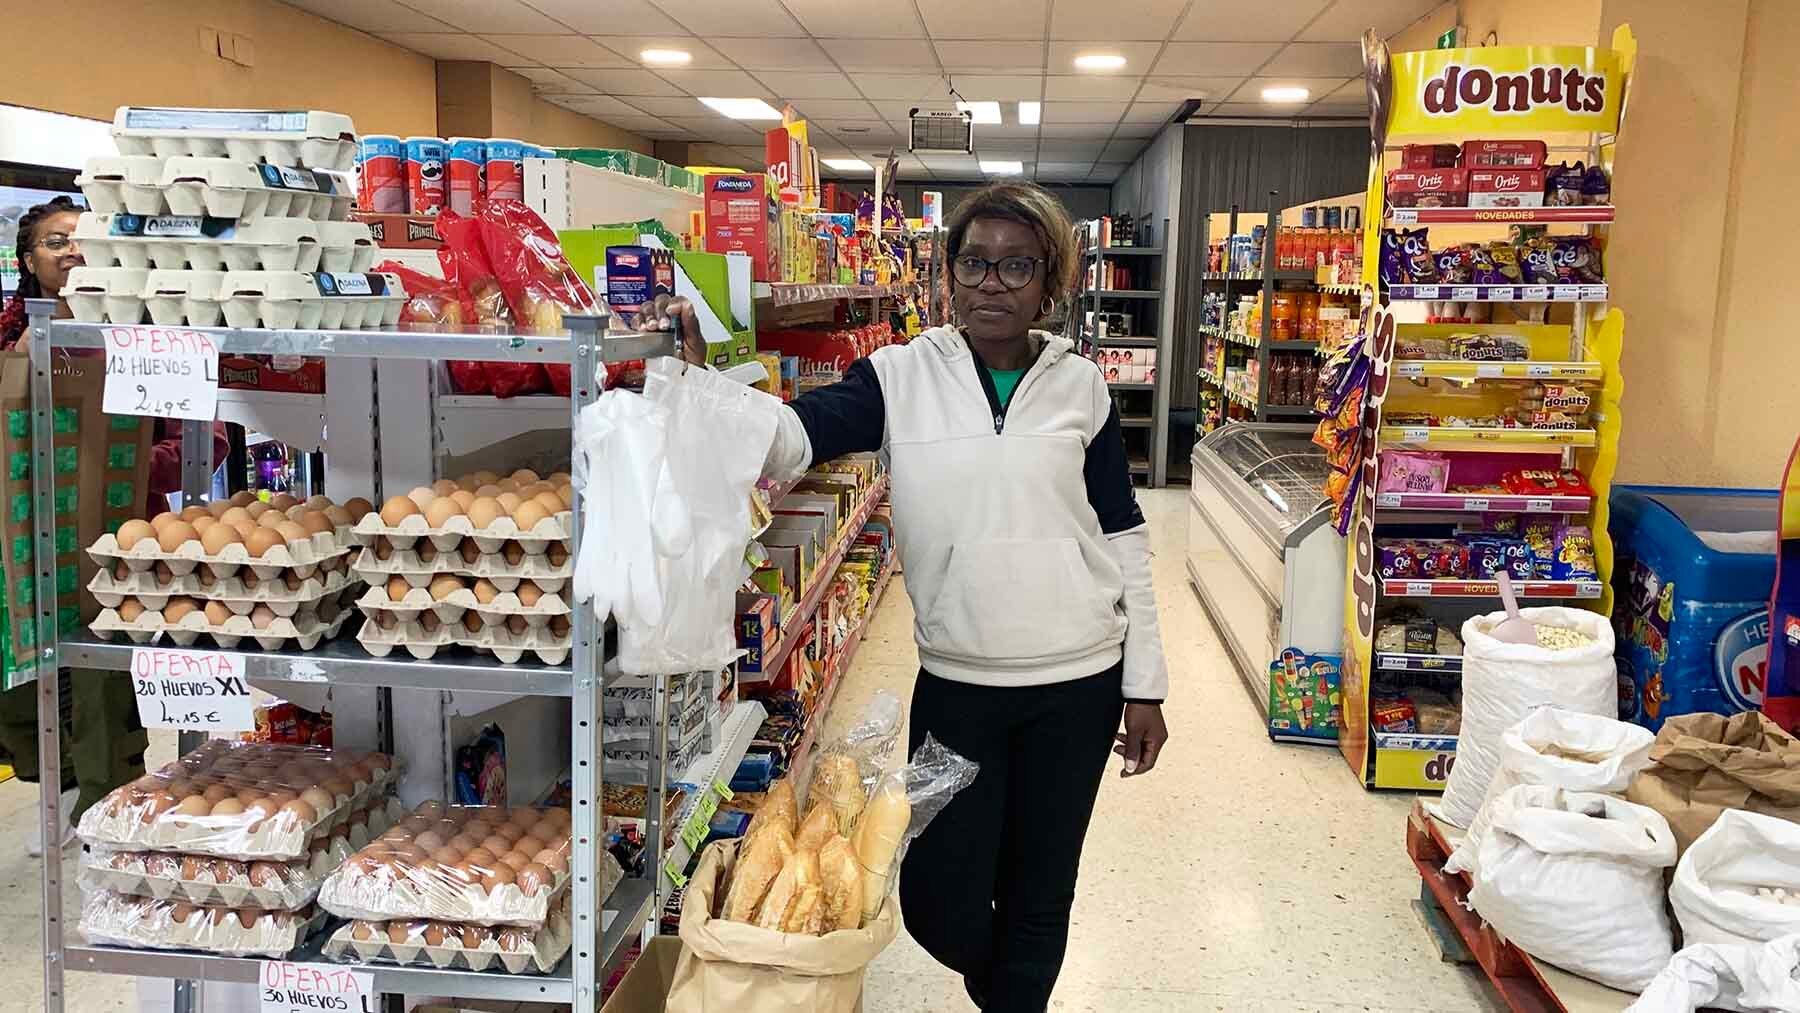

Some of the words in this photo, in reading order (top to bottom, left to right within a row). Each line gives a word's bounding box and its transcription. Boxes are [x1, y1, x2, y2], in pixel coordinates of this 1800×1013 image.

[1424, 66, 1605, 113] donuts
[1418, 173, 1443, 191] Ortiz
[1495, 174, 1520, 191] Ortiz
[1475, 211, 1535, 219] NOVEDADES
[112, 327, 216, 356] OFERTA
[1462, 346, 1503, 359] donuts
[106, 355, 126, 375] 12
[131, 355, 191, 376] HUEVOS
[205, 358, 218, 382] L
[1544, 397, 1589, 408] donuts
[137, 651, 233, 678] OFERTA
[137, 679, 156, 696] 20
[161, 679, 215, 696] HUEVOS
[215, 676, 250, 696] XL
[267, 960, 360, 993] OFERTA
[264, 988, 284, 1003] 30
[287, 989, 348, 1010] HUEVOS
